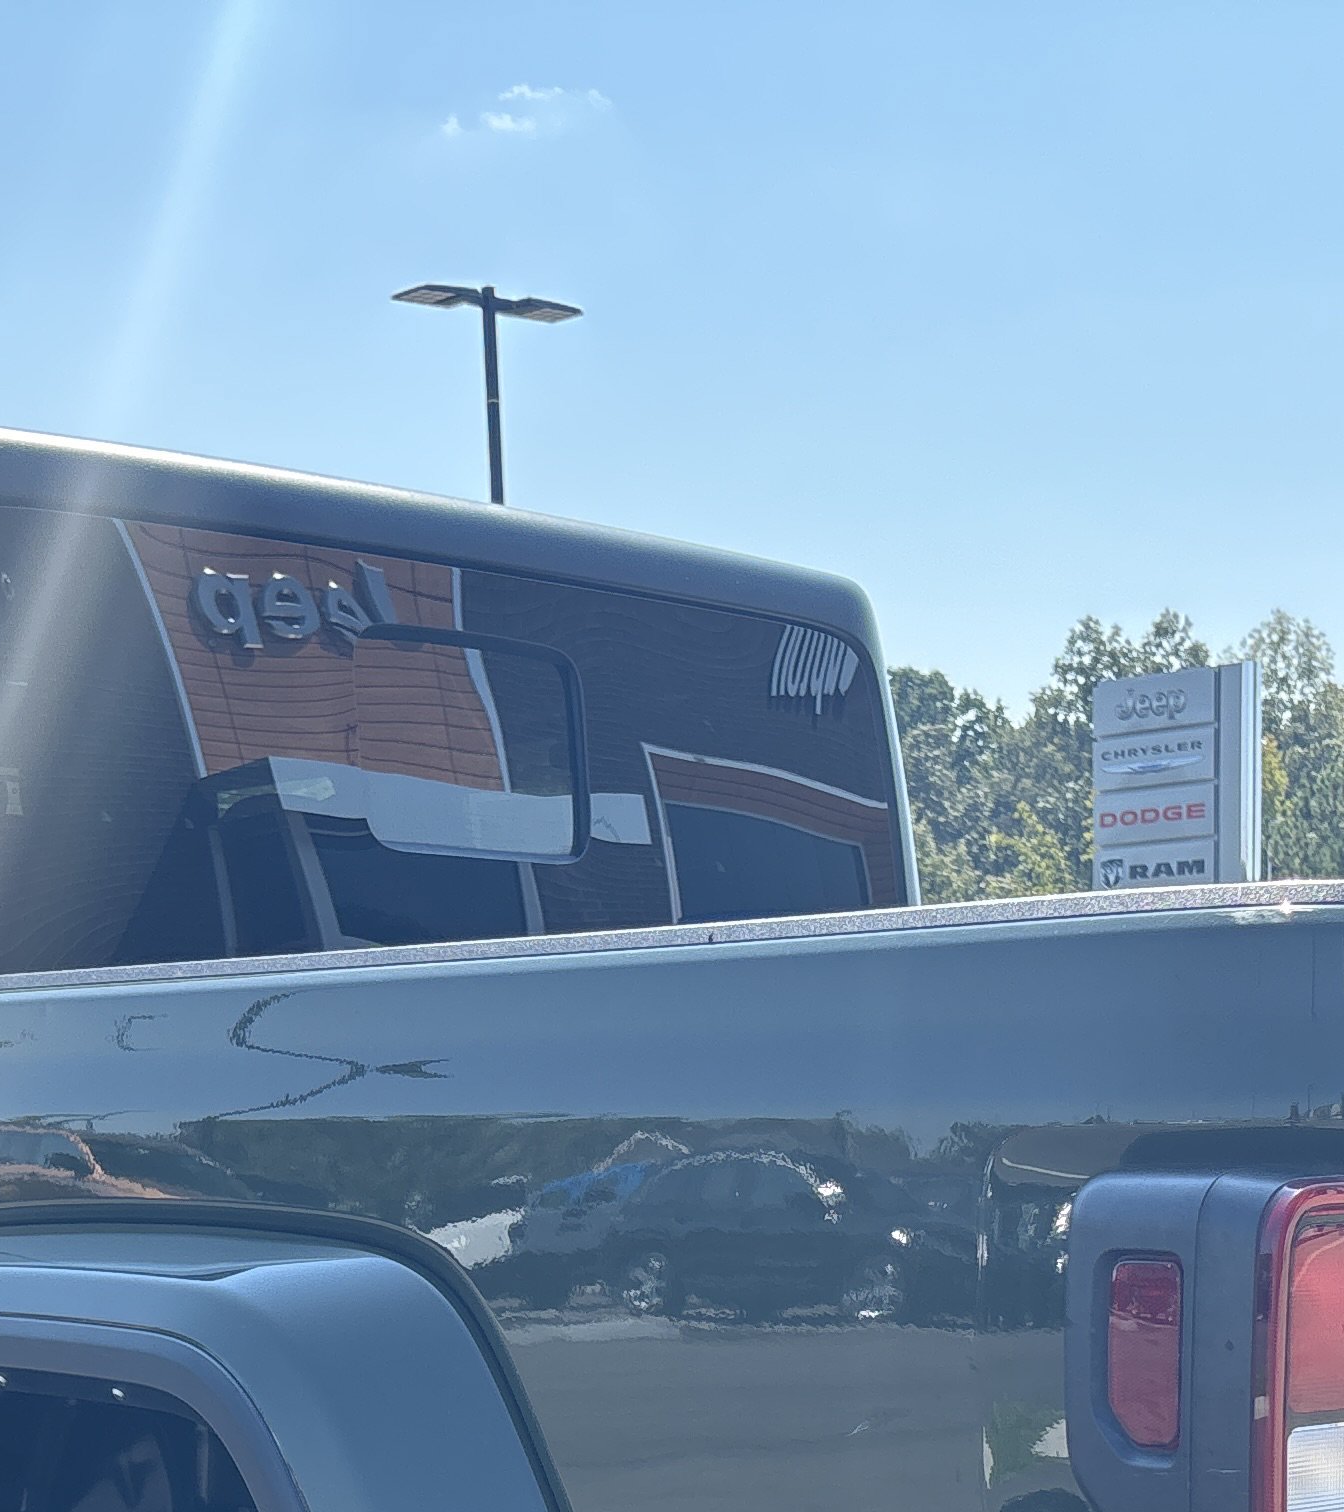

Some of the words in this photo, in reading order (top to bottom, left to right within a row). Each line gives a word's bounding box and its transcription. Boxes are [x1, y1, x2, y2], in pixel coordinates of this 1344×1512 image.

[1114, 688, 1187, 721] Jeep
[1101, 740, 1203, 761] CHRYSLER
[1099, 803, 1206, 828] DODGE
[1129, 858, 1205, 880] RAM
